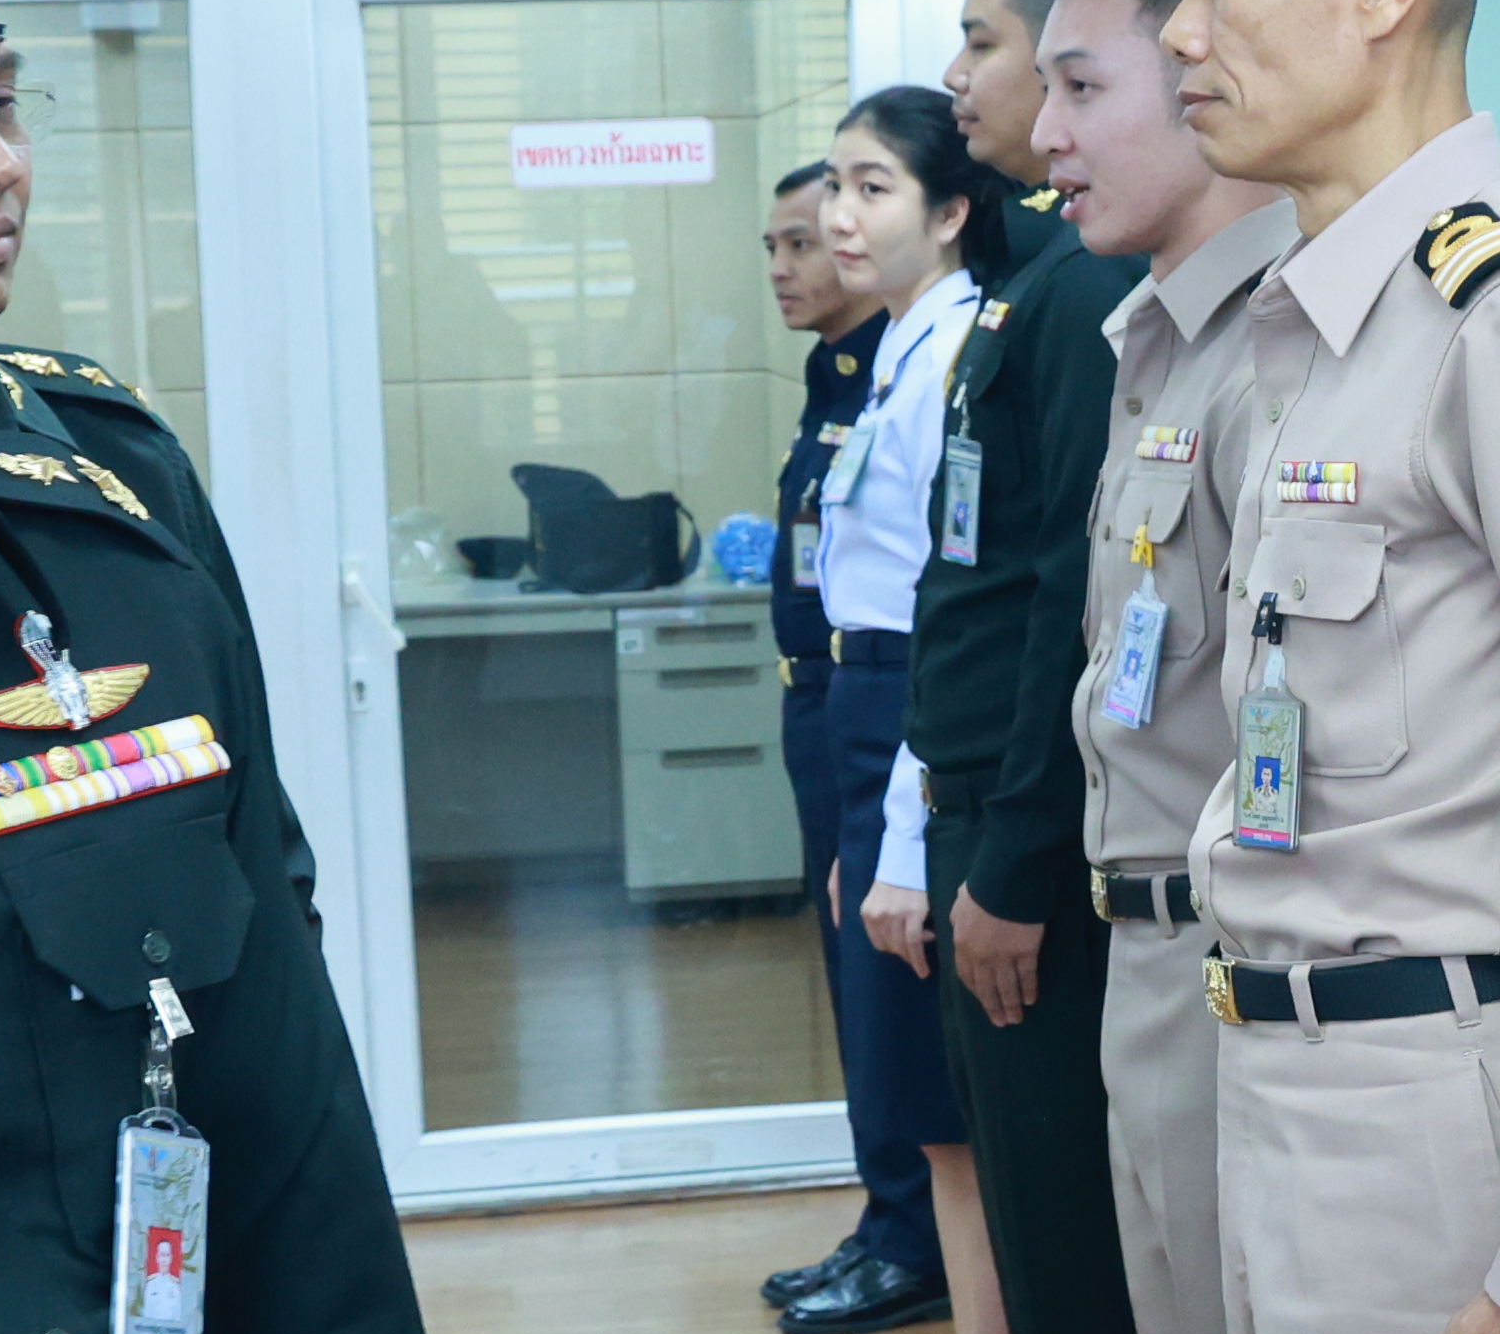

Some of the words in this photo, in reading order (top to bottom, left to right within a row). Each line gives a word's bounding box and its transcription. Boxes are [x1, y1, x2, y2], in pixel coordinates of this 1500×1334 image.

[517, 131, 705, 167] เขตหวงห้ามเฉพาะ
